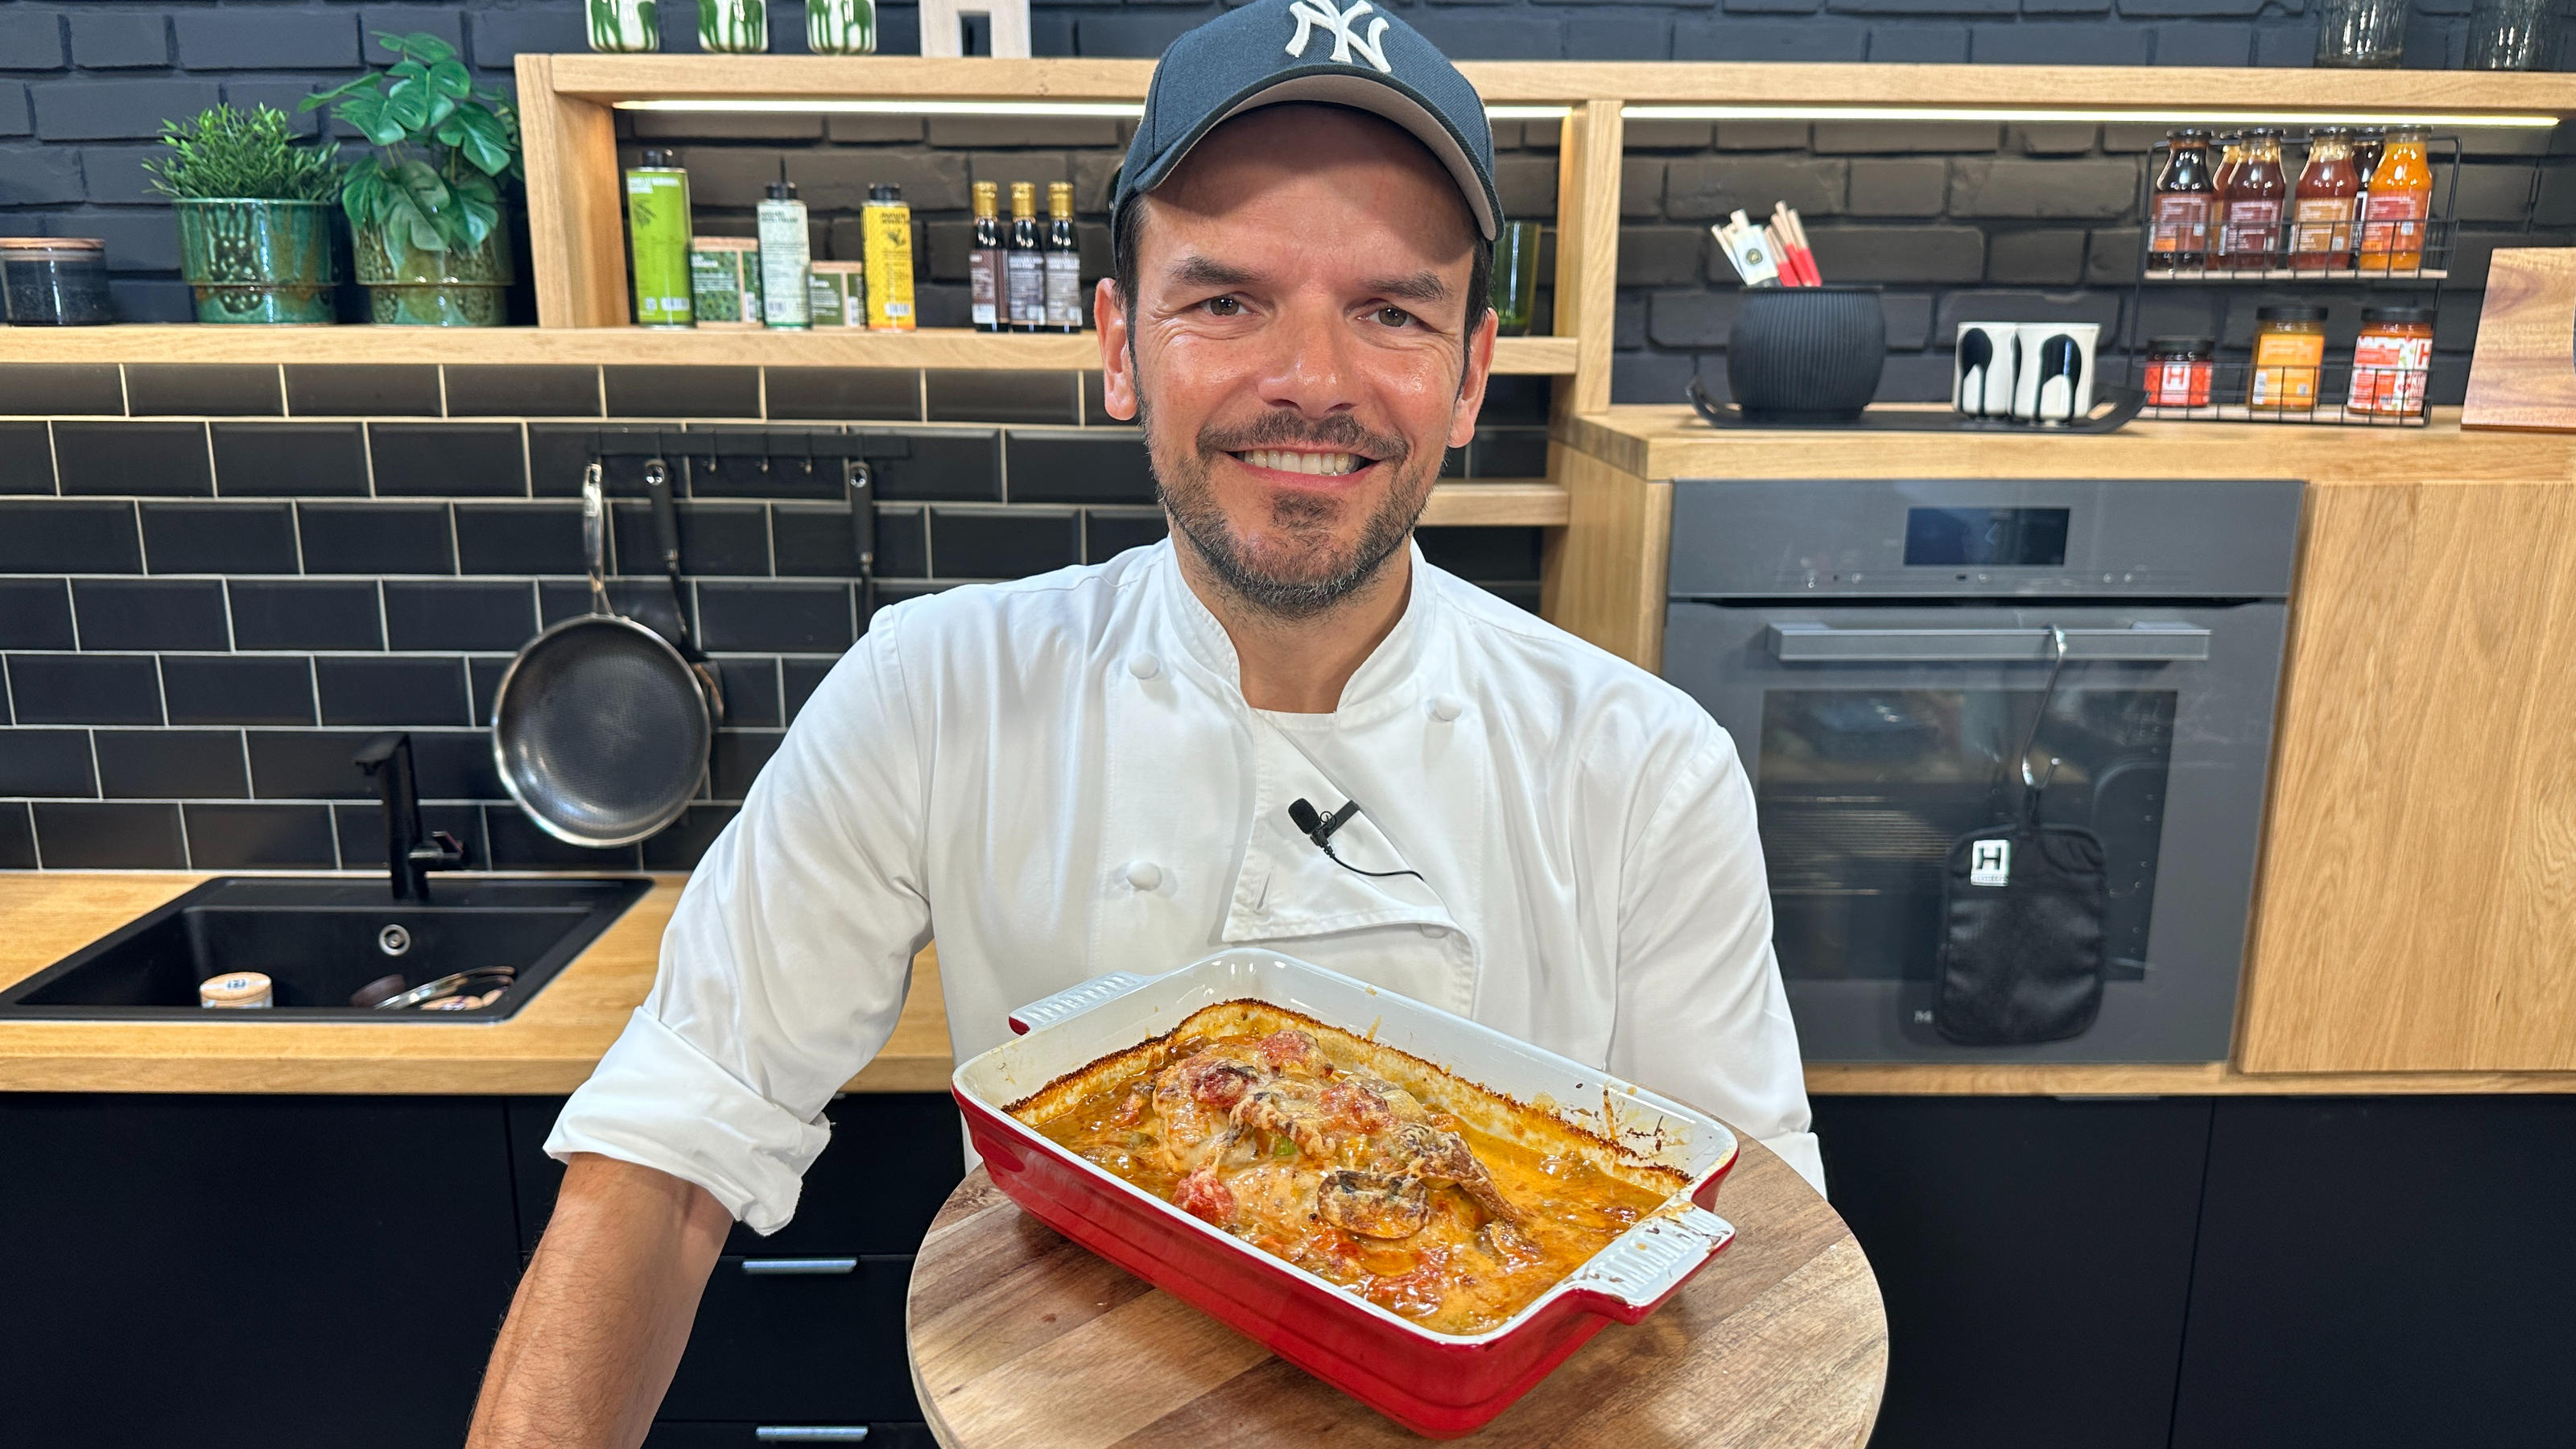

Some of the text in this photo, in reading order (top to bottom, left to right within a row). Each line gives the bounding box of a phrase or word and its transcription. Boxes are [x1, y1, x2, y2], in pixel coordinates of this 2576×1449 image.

[1285, 0, 1392, 73] NY
[2166, 365, 2186, 386] H
[1977, 847, 2001, 870] H
